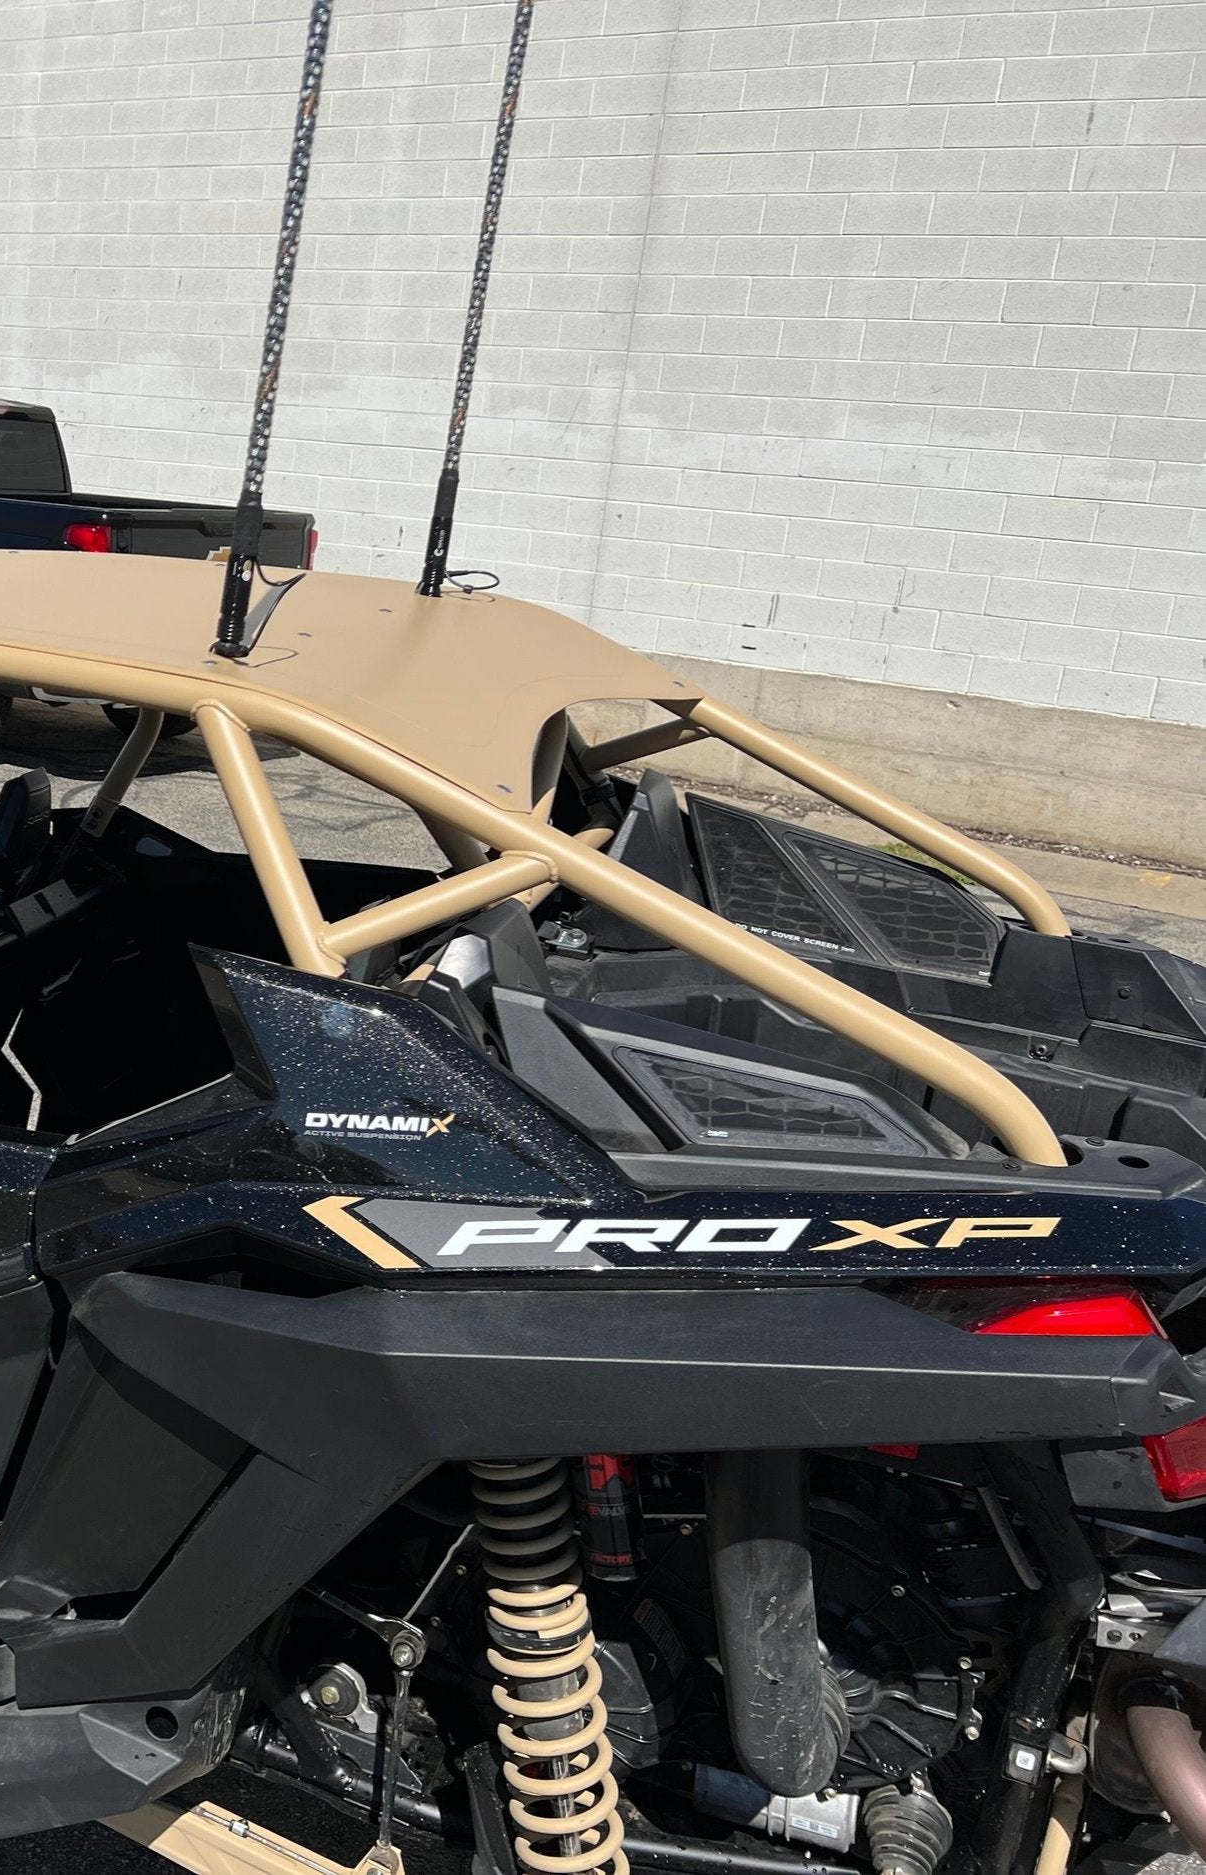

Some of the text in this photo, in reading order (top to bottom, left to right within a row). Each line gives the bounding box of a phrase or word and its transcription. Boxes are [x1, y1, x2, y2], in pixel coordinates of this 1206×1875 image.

[751, 926, 768, 935] NOT
[771, 930, 800, 942] COVER
[804, 937, 838, 949] SCREEN
[303, 1130, 422, 1140] ACTIVE SUSPENSION
[304, 1112, 456, 1138] DYNAMIX
[436, 1216, 1062, 1256] PRO XP
